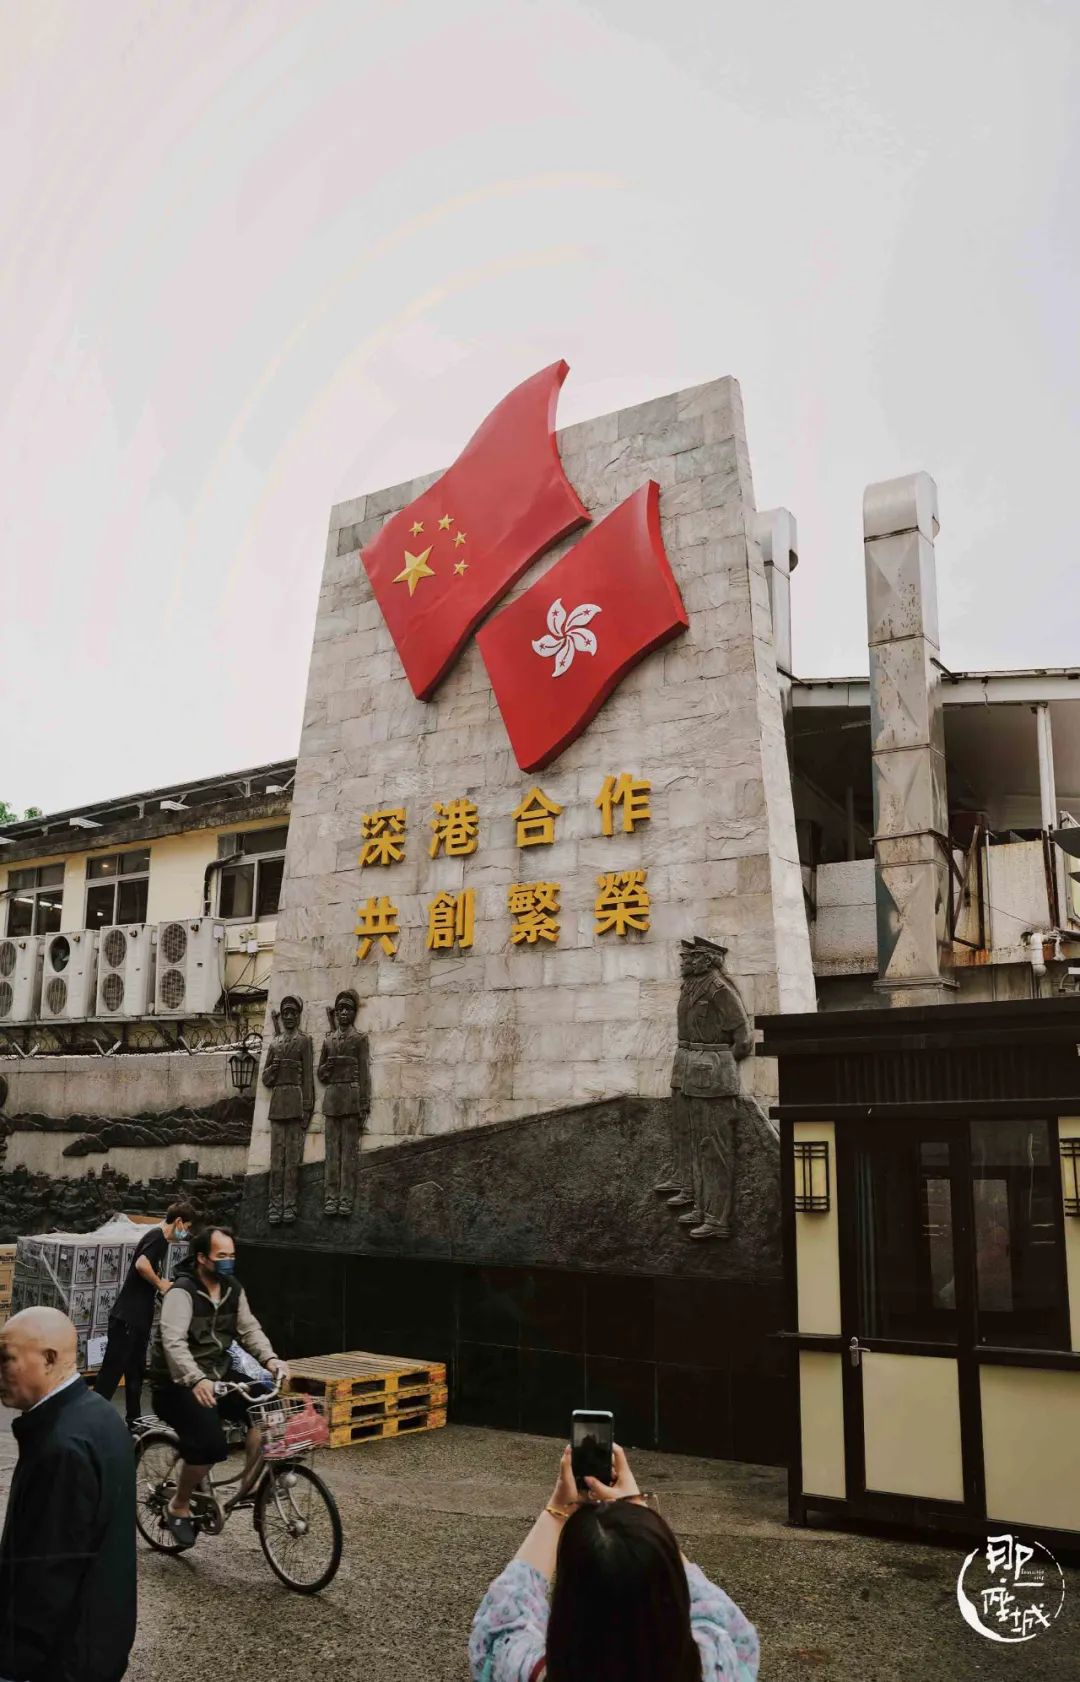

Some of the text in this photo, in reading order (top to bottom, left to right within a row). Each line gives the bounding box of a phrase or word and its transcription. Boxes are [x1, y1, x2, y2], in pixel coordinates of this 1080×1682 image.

[358, 772, 651, 866] 深港合作
[354, 869, 651, 960] 共創繁榮
